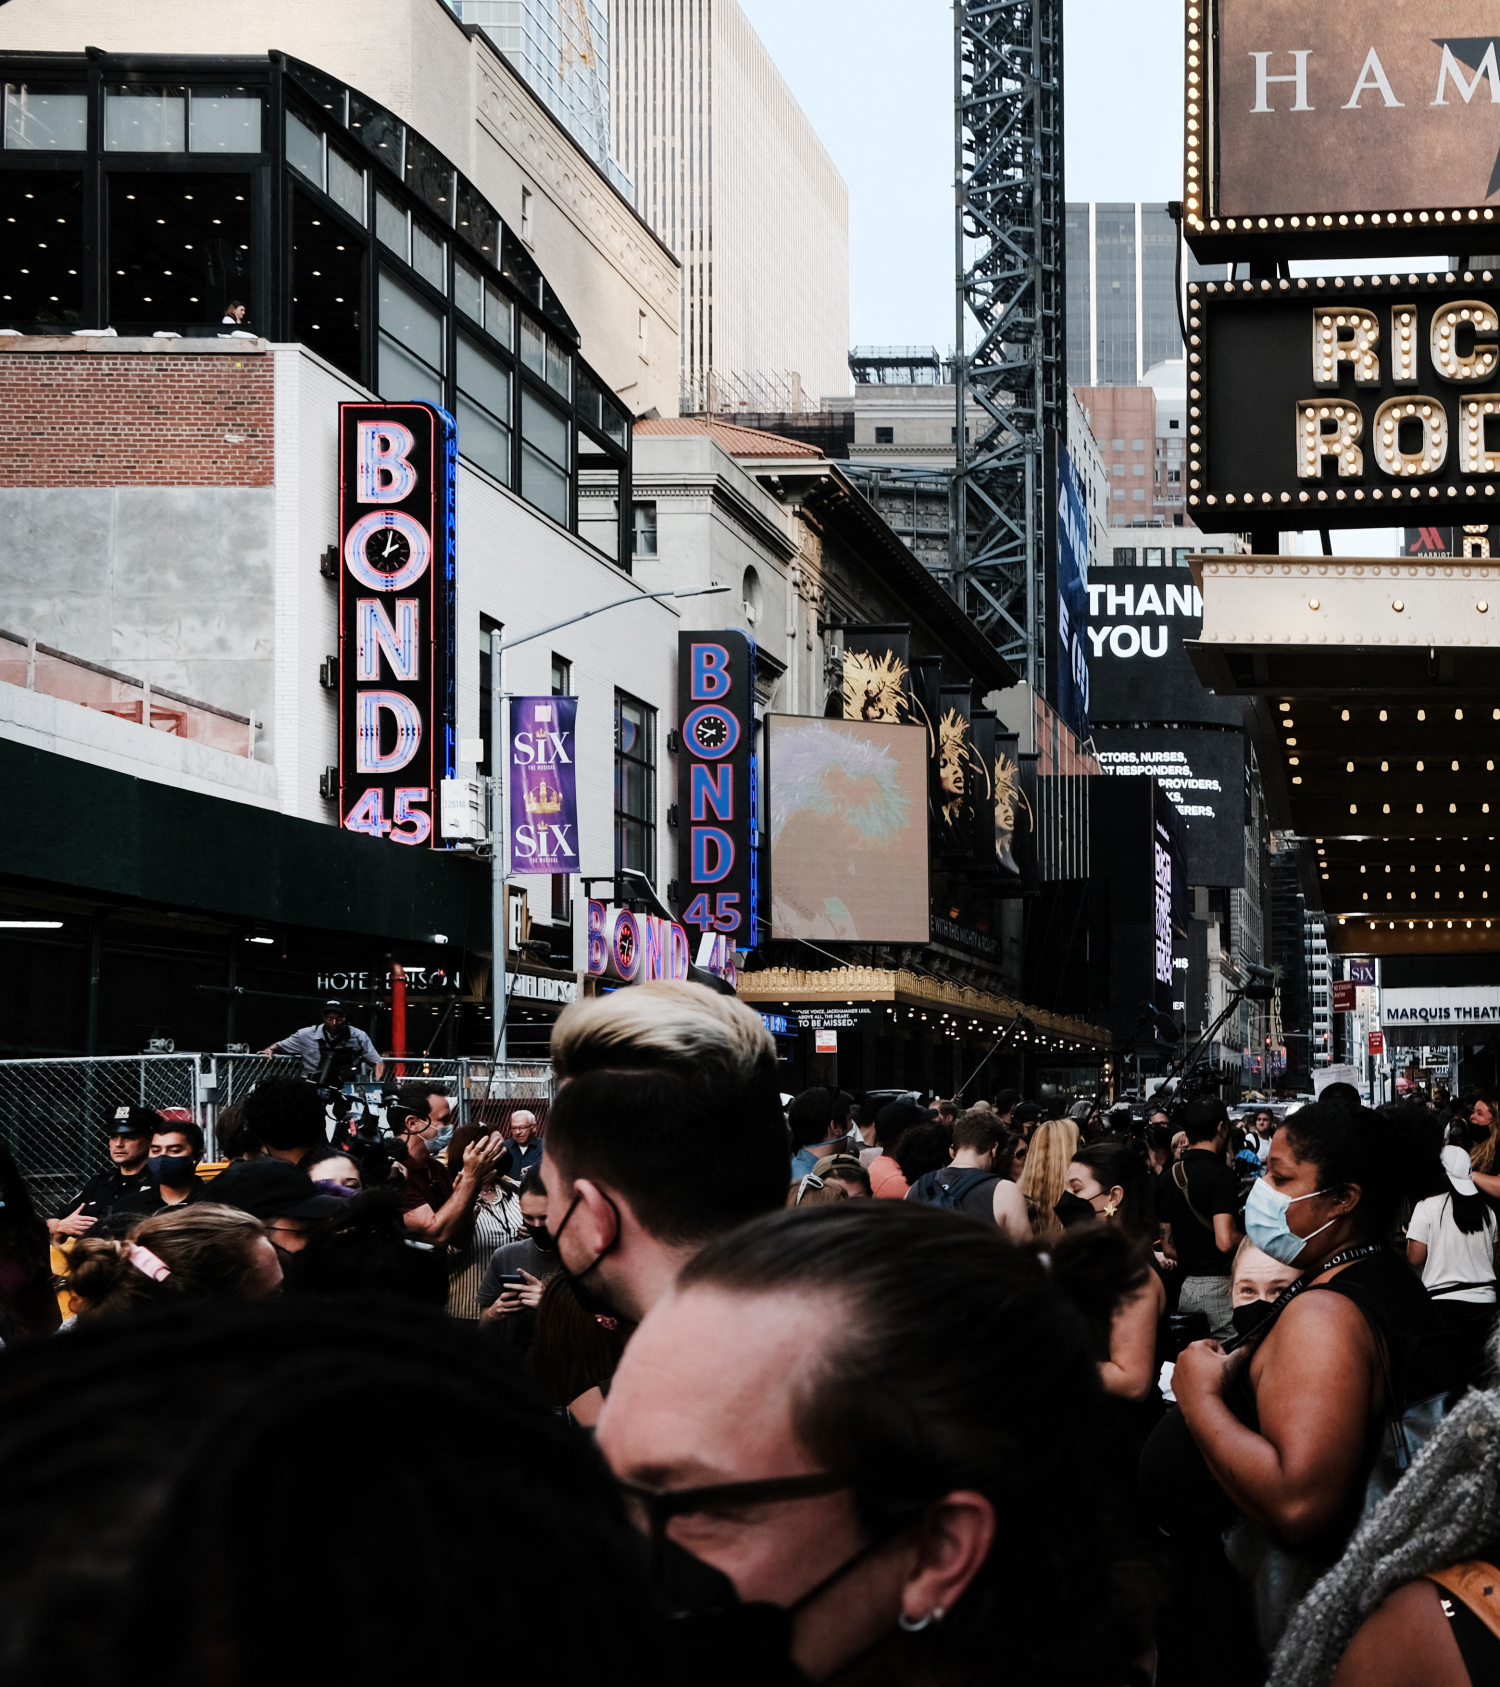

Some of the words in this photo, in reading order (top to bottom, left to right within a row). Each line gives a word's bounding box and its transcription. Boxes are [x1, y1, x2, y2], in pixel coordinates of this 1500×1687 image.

[345, 420, 431, 774] BOND
[1087, 624, 1168, 658] YOU
[513, 731, 573, 765] SIX
[682, 643, 741, 884] BOND
[1140, 752, 1187, 764] NURSES,
[1116, 765, 1193, 777] RESPONDERS,
[345, 787, 432, 846] 45
[514, 824, 577, 858] SIX
[682, 892, 742, 933] 45
[587, 898, 690, 984] BOND
[317, 972, 372, 990] HOTE
[811, 1019, 821, 1027] BE
[1386, 1006, 1451, 1023] MARQUIS
